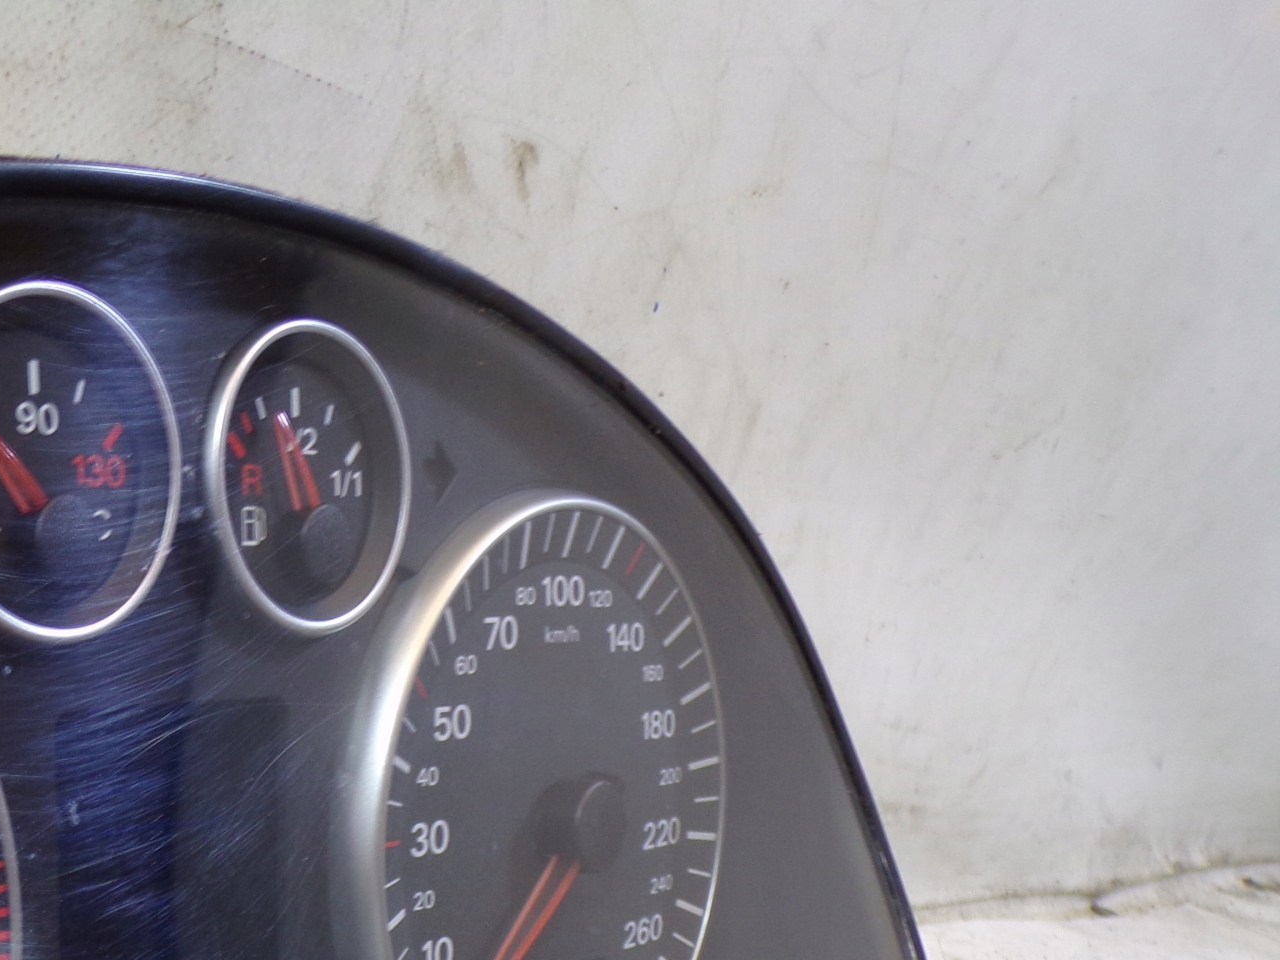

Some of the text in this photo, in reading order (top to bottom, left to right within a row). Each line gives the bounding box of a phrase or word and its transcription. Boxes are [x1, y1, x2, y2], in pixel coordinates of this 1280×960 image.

[15, 401, 59, 436] 90
[72, 454, 126, 488] 130
[241, 463, 263, 496] R
[329, 470, 363, 498] 1/1
[515, 587, 537, 606] 80
[541, 575, 586, 607] 100
[588, 590, 613, 608] 120
[483, 615, 519, 651] 70
[606, 622, 645, 653] 140
[454, 655, 478, 676] 60
[642, 664, 664, 682] 160
[433, 704, 472, 742] 50
[641, 710, 676, 740] 180
[415, 766, 440, 787] 40
[659, 767, 683, 786] 200
[409, 819, 450, 858] 30
[642, 817, 682, 851] 220
[649, 874, 674, 895] 240
[413, 889, 436, 911] 20
[623, 914, 664, 951] 260
